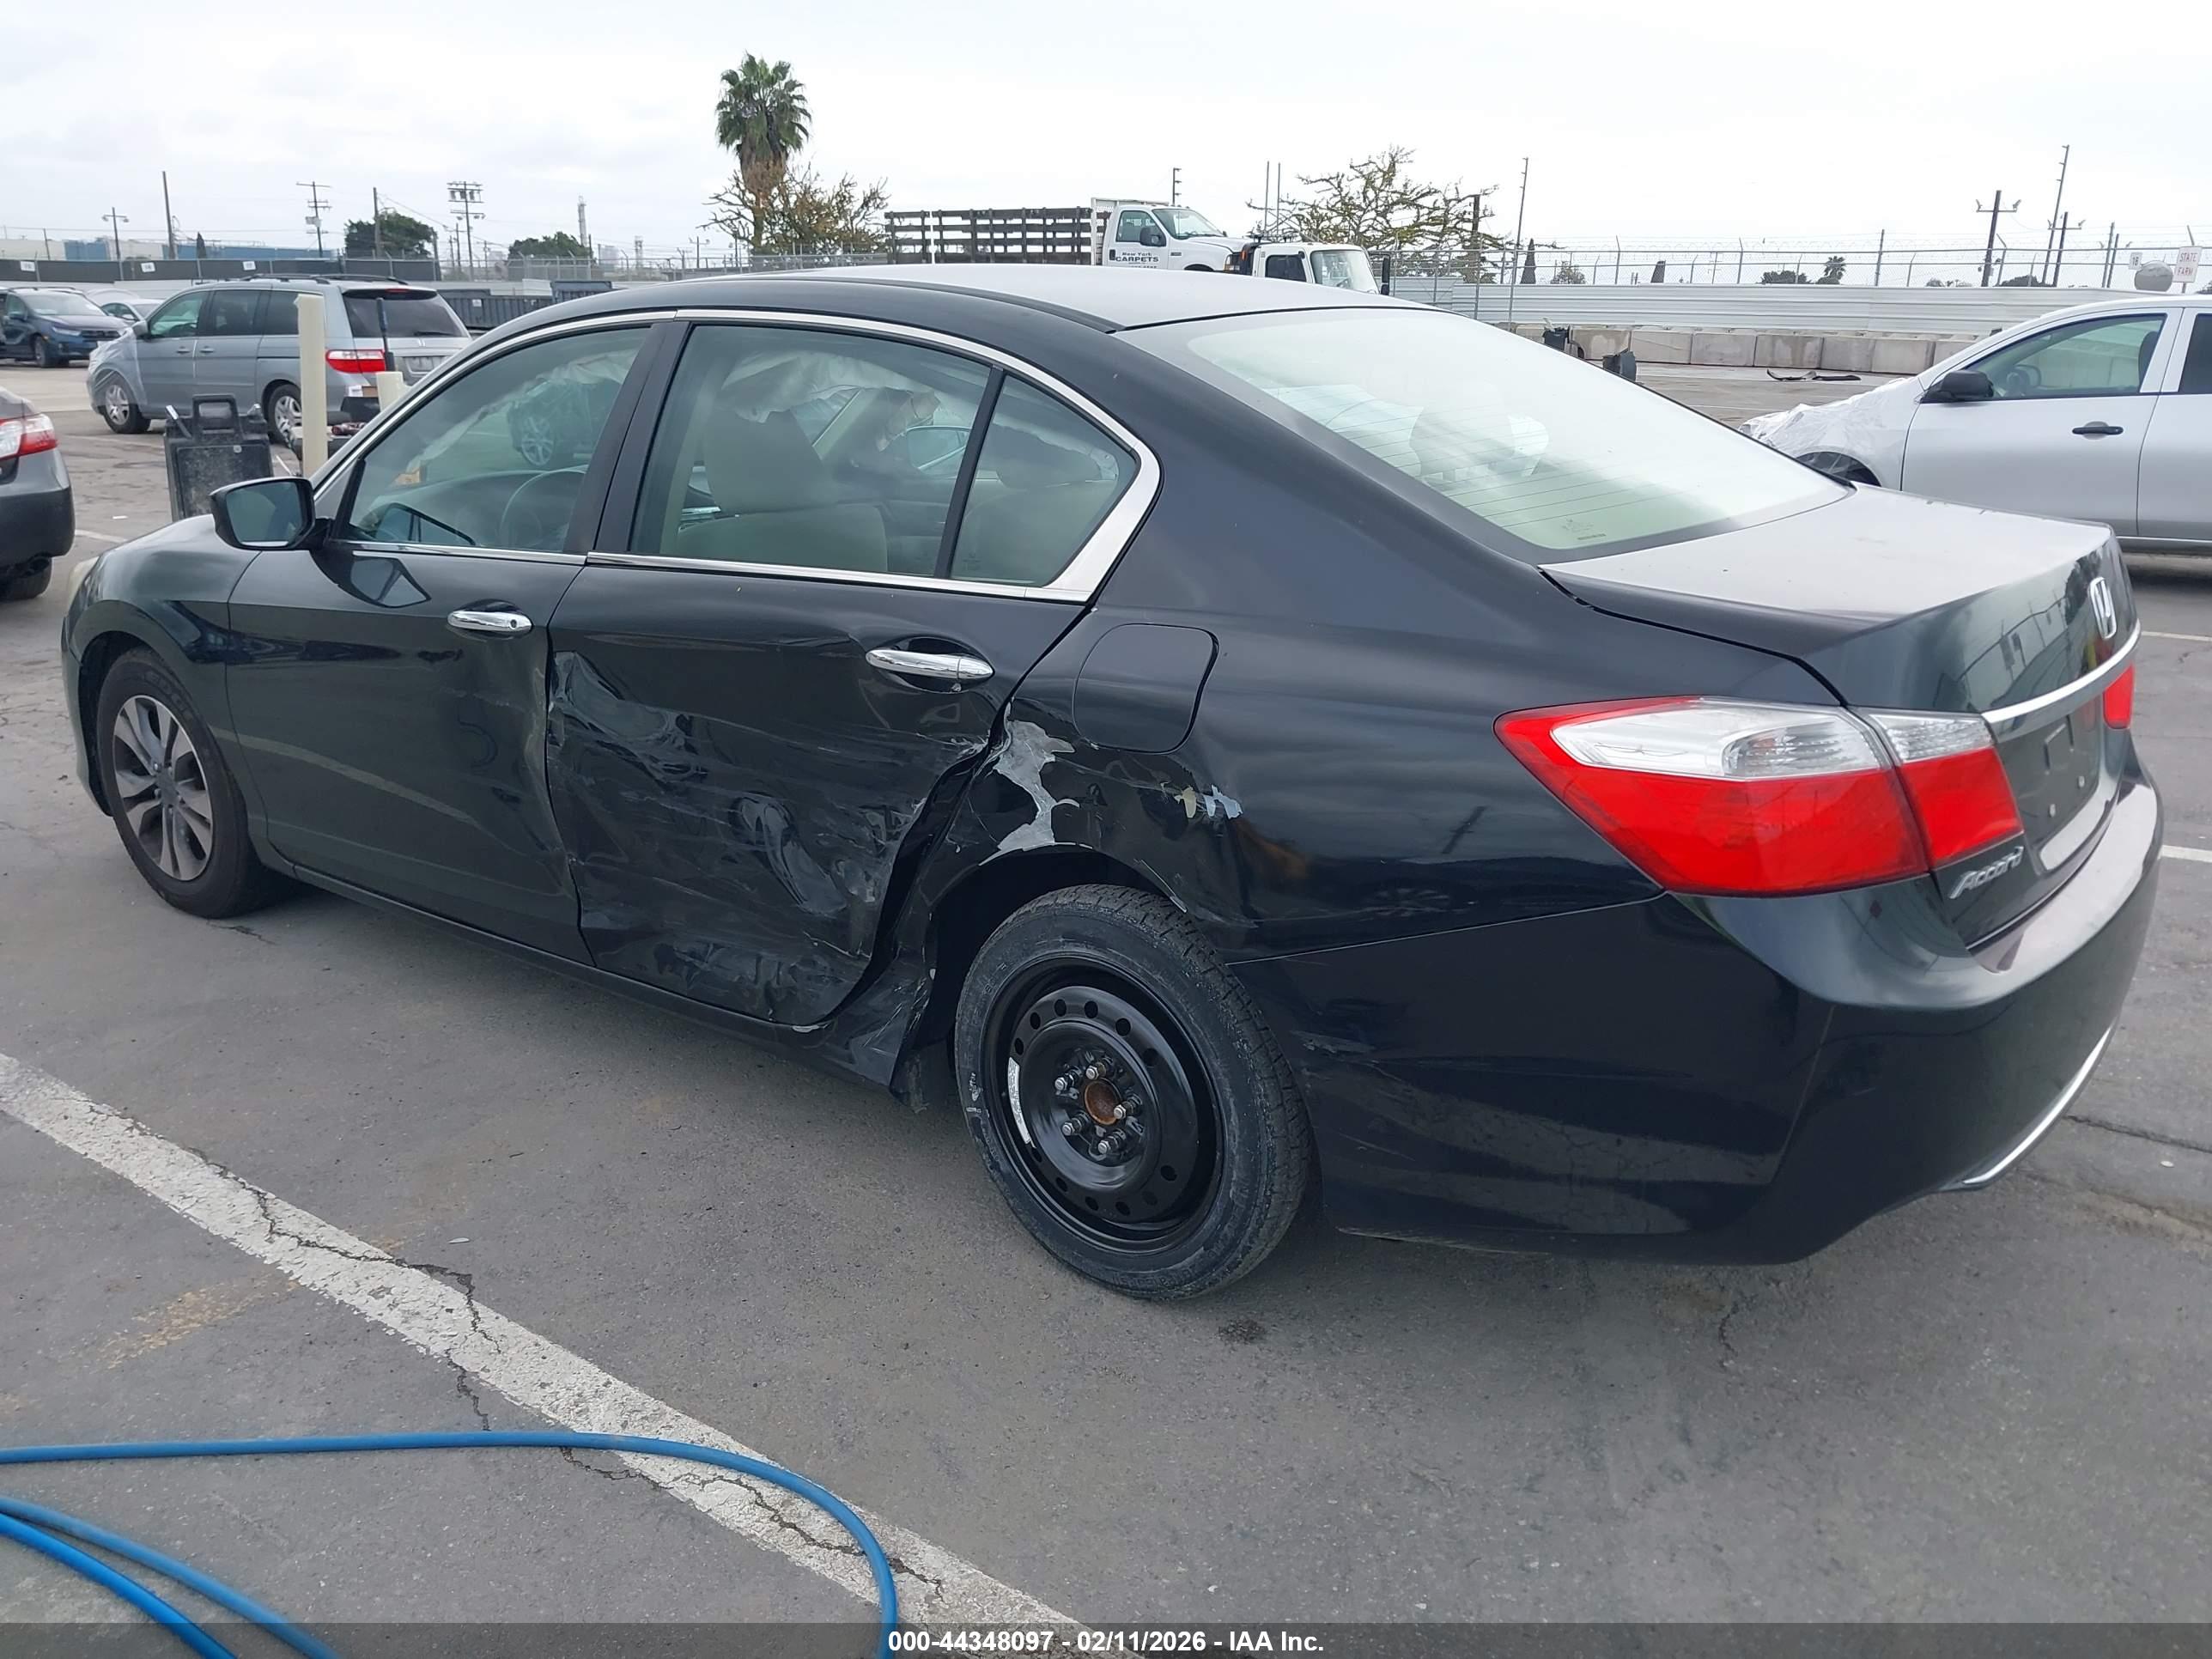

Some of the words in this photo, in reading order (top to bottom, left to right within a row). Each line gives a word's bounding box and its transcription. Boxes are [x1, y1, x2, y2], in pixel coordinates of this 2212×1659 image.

[2179, 252, 2198, 262] STATE
[2178, 267, 2193, 276] FARM
[1948, 845, 2025, 899] Accord
